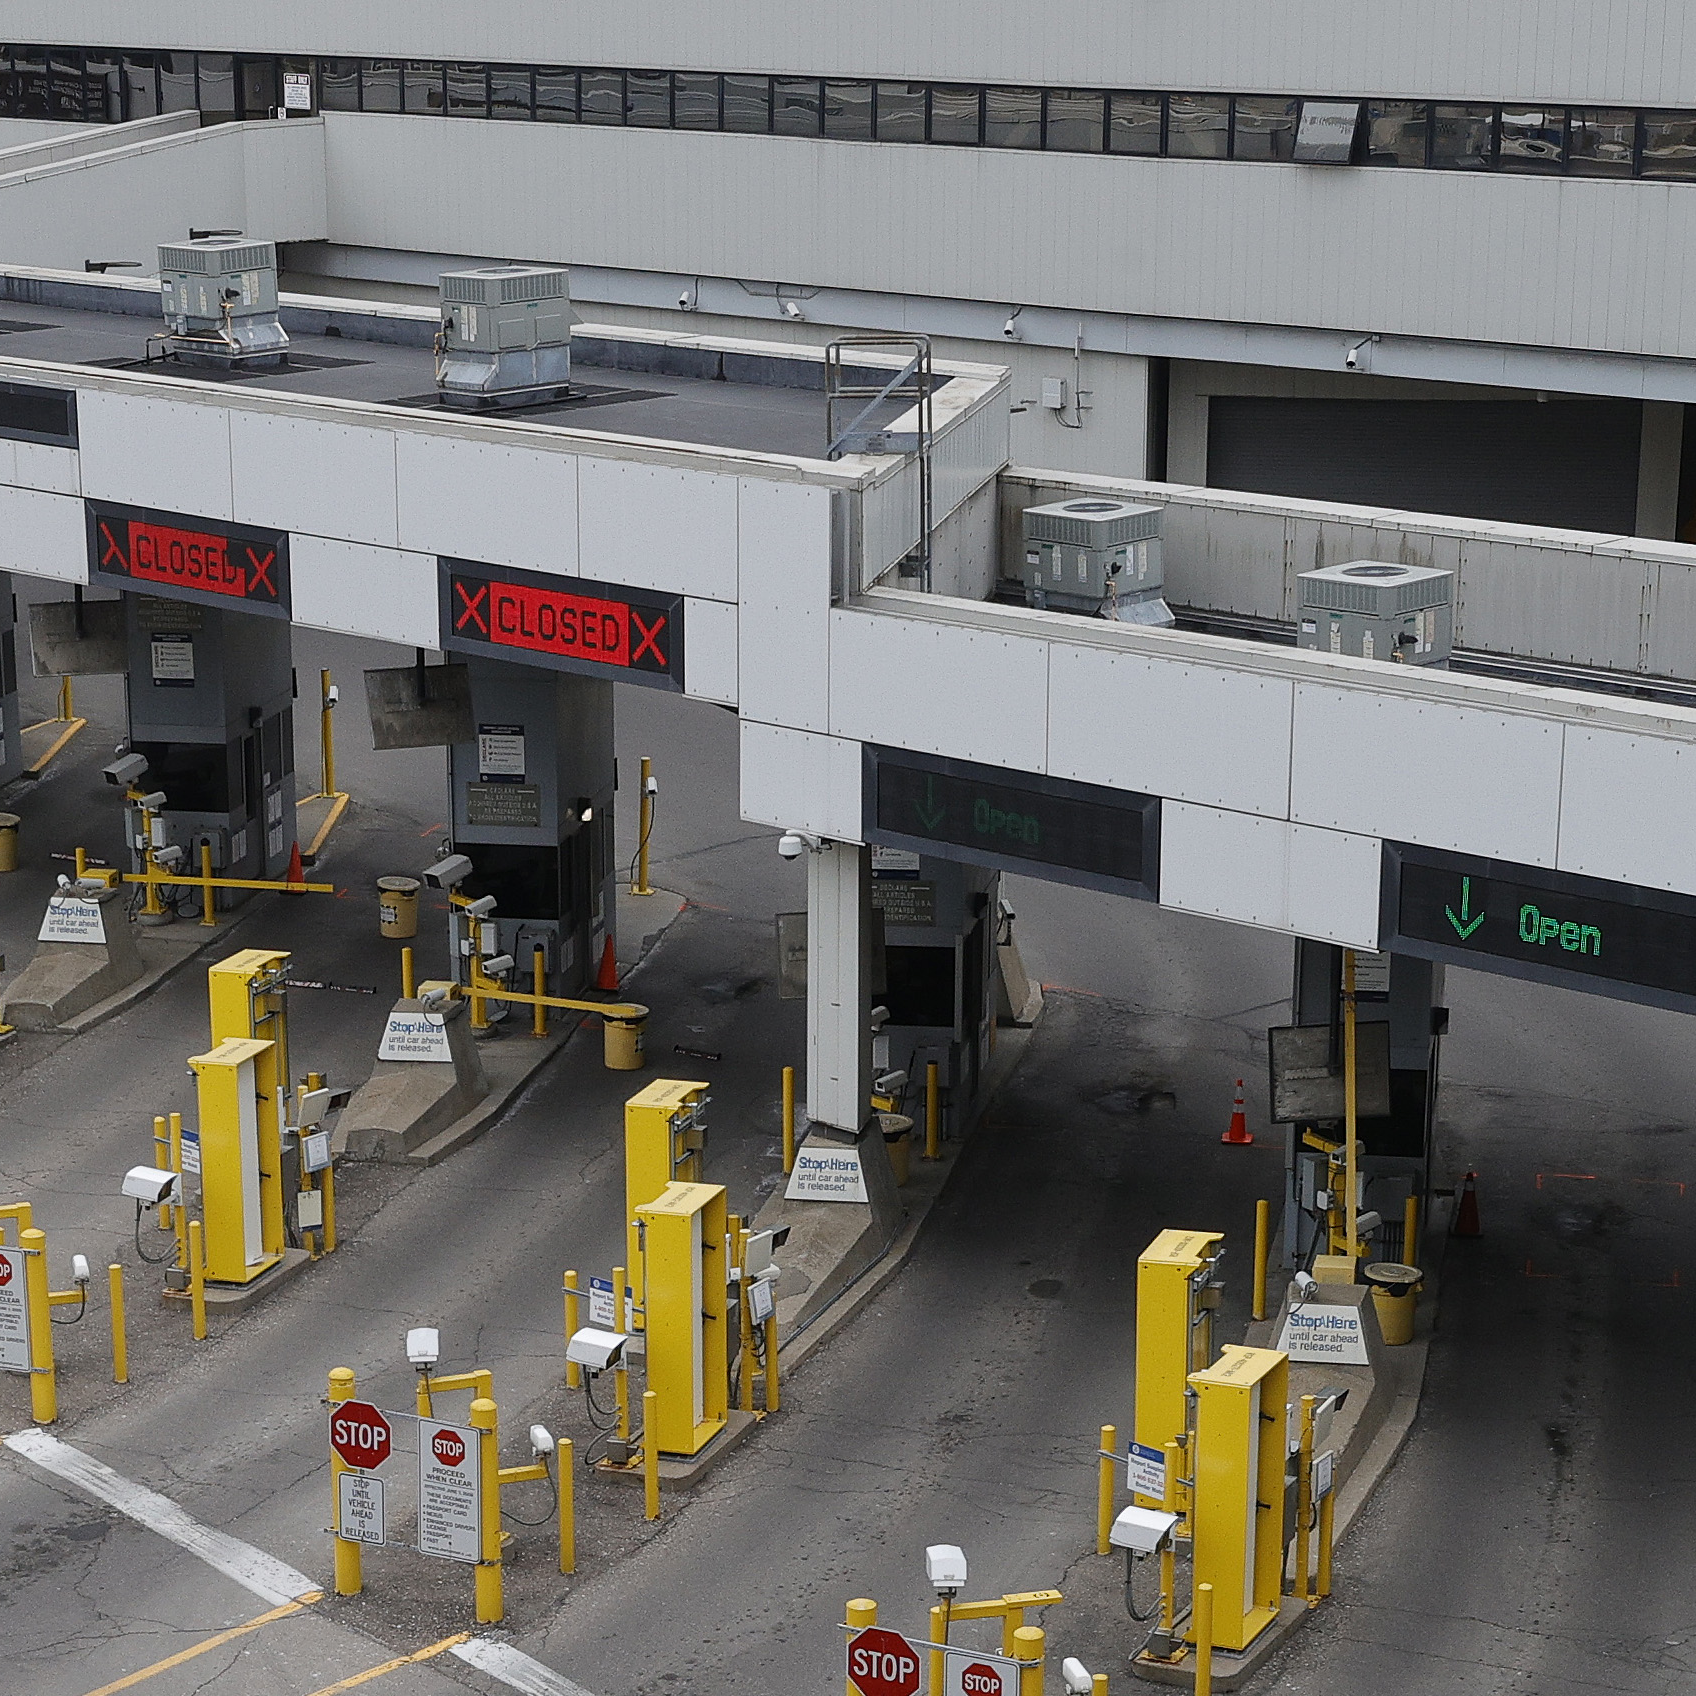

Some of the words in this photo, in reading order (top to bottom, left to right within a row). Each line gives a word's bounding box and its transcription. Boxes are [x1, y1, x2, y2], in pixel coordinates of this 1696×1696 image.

[498, 597, 620, 651] CLOSED
[974, 799, 1040, 844] Open
[1519, 903, 1602, 956] Open
[834, 1175, 859, 1183] ahead
[1290, 1332, 1310, 1341] until
[1330, 1333, 1358, 1343] ahead
[1289, 1341, 1297, 1349] is
[1300, 1342, 1344, 1352] released.
[335, 1419, 386, 1451] STOP
[434, 1439, 464, 1457] STOP
[432, 1467, 465, 1478] PROCEED
[353, 1480, 369, 1489] STOP
[426, 1473, 446, 1483] WHEN
[450, 1478, 472, 1487] CLEAR
[352, 1490, 370, 1500] UNTIL
[348, 1499, 376, 1510] VEHICLE
[351, 1509, 373, 1519] AHEAD
[359, 1520, 365, 1528] IS
[345, 1527, 379, 1540] RELEASED
[853, 1648, 915, 1684] STOP
[964, 1674, 1000, 1695] STOP
